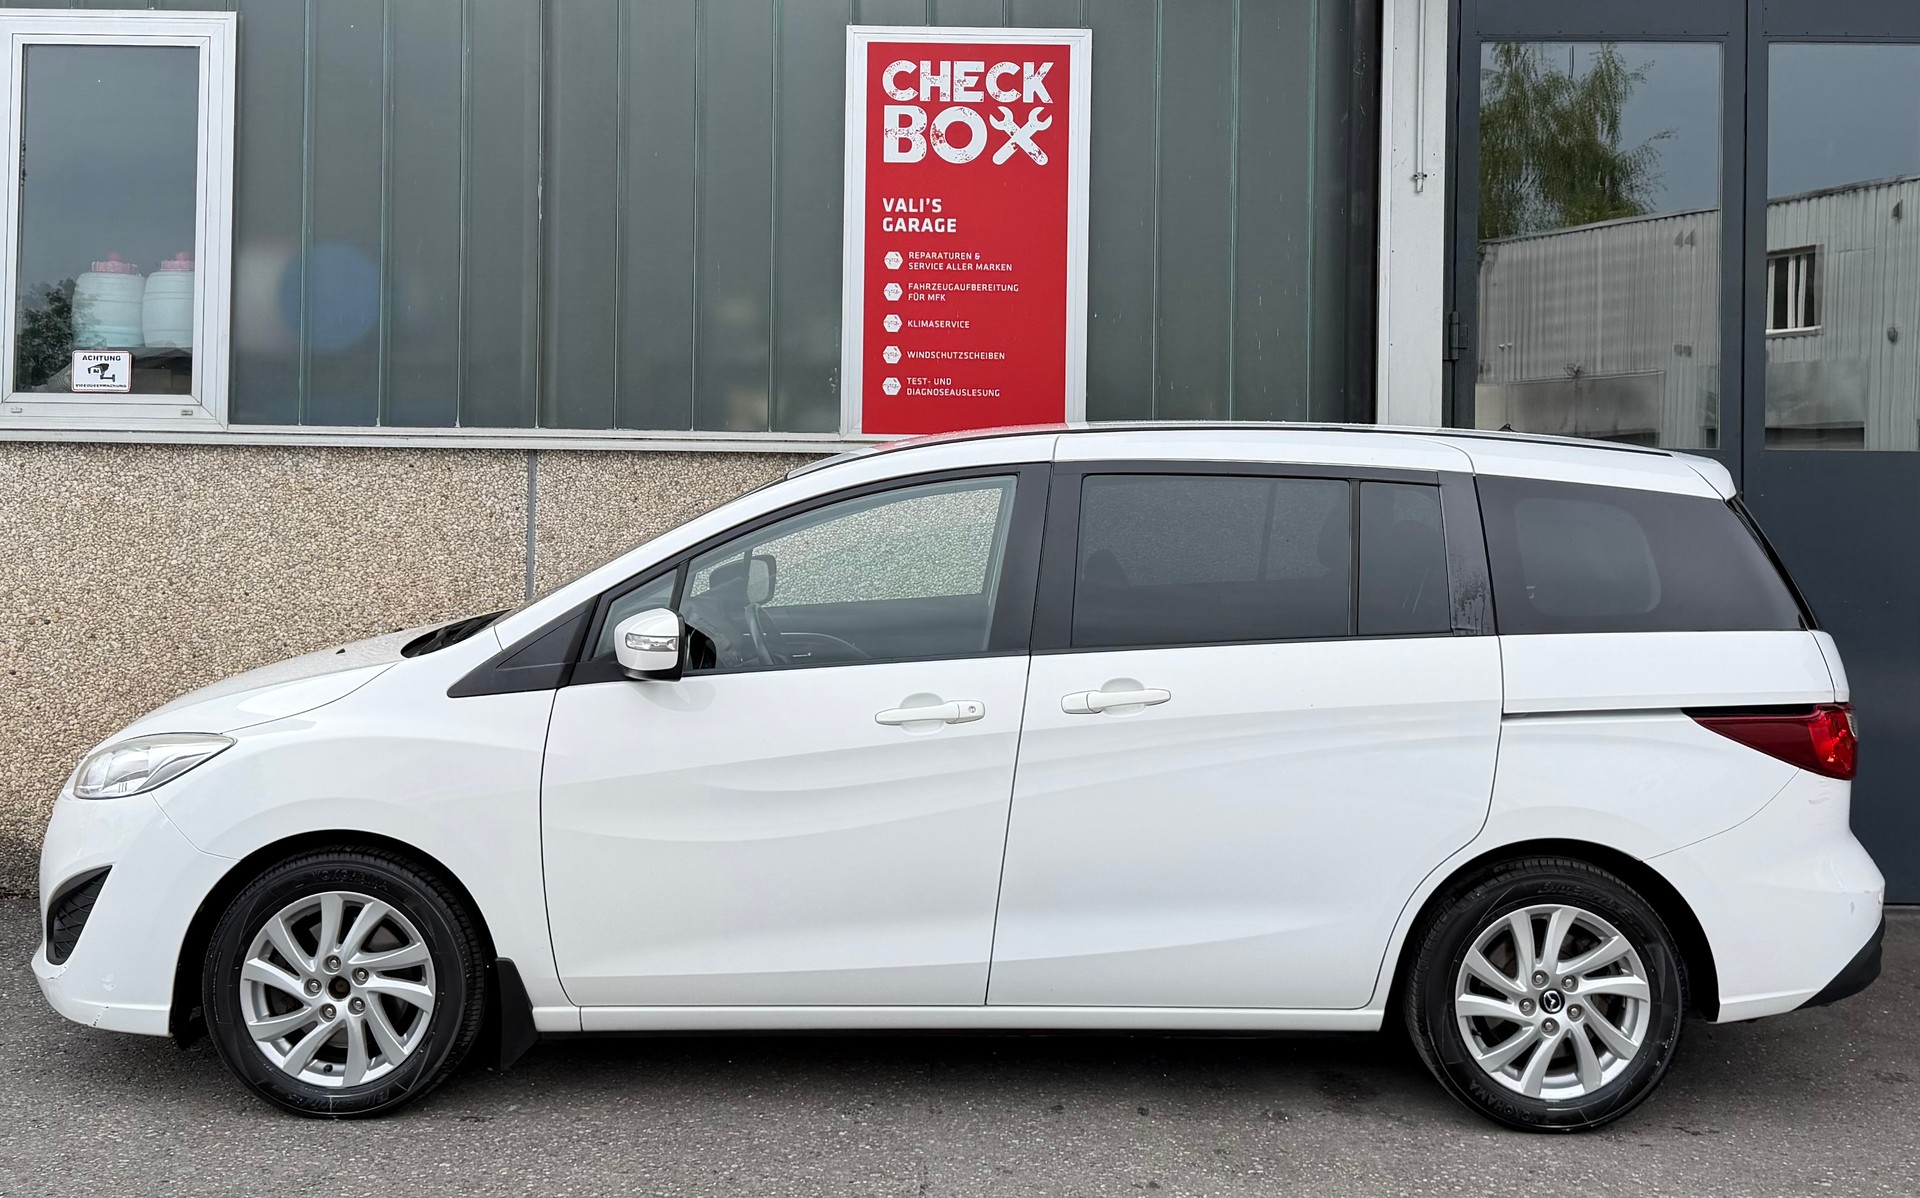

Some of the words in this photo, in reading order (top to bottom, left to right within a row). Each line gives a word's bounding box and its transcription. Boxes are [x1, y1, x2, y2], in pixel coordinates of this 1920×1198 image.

[882, 60, 1054, 104] CHECK
[882, 104, 1053, 166] BOX
[882, 197, 943, 214] VALI'S
[882, 217, 957, 233] GARAGE
[908, 251, 972, 260] REPARATUREN
[974, 252, 981, 261] &
[908, 262, 944, 271] SERVICE
[946, 263, 973, 271] ALLER
[975, 263, 1013, 272] MARKEN
[908, 282, 1019, 292] FAHRZEUGAUFBEREITUNG
[908, 292, 926, 302] FÜR
[927, 294, 946, 302] MFK
[907, 319, 970, 329] KLIMASERVICE
[907, 350, 1005, 360] WINDSCHUTZSCHEIBEN
[907, 377, 931, 386] TEST-
[933, 378, 952, 386] UND
[907, 388, 1000, 397] DIAGNOSEAUSLESUNG
